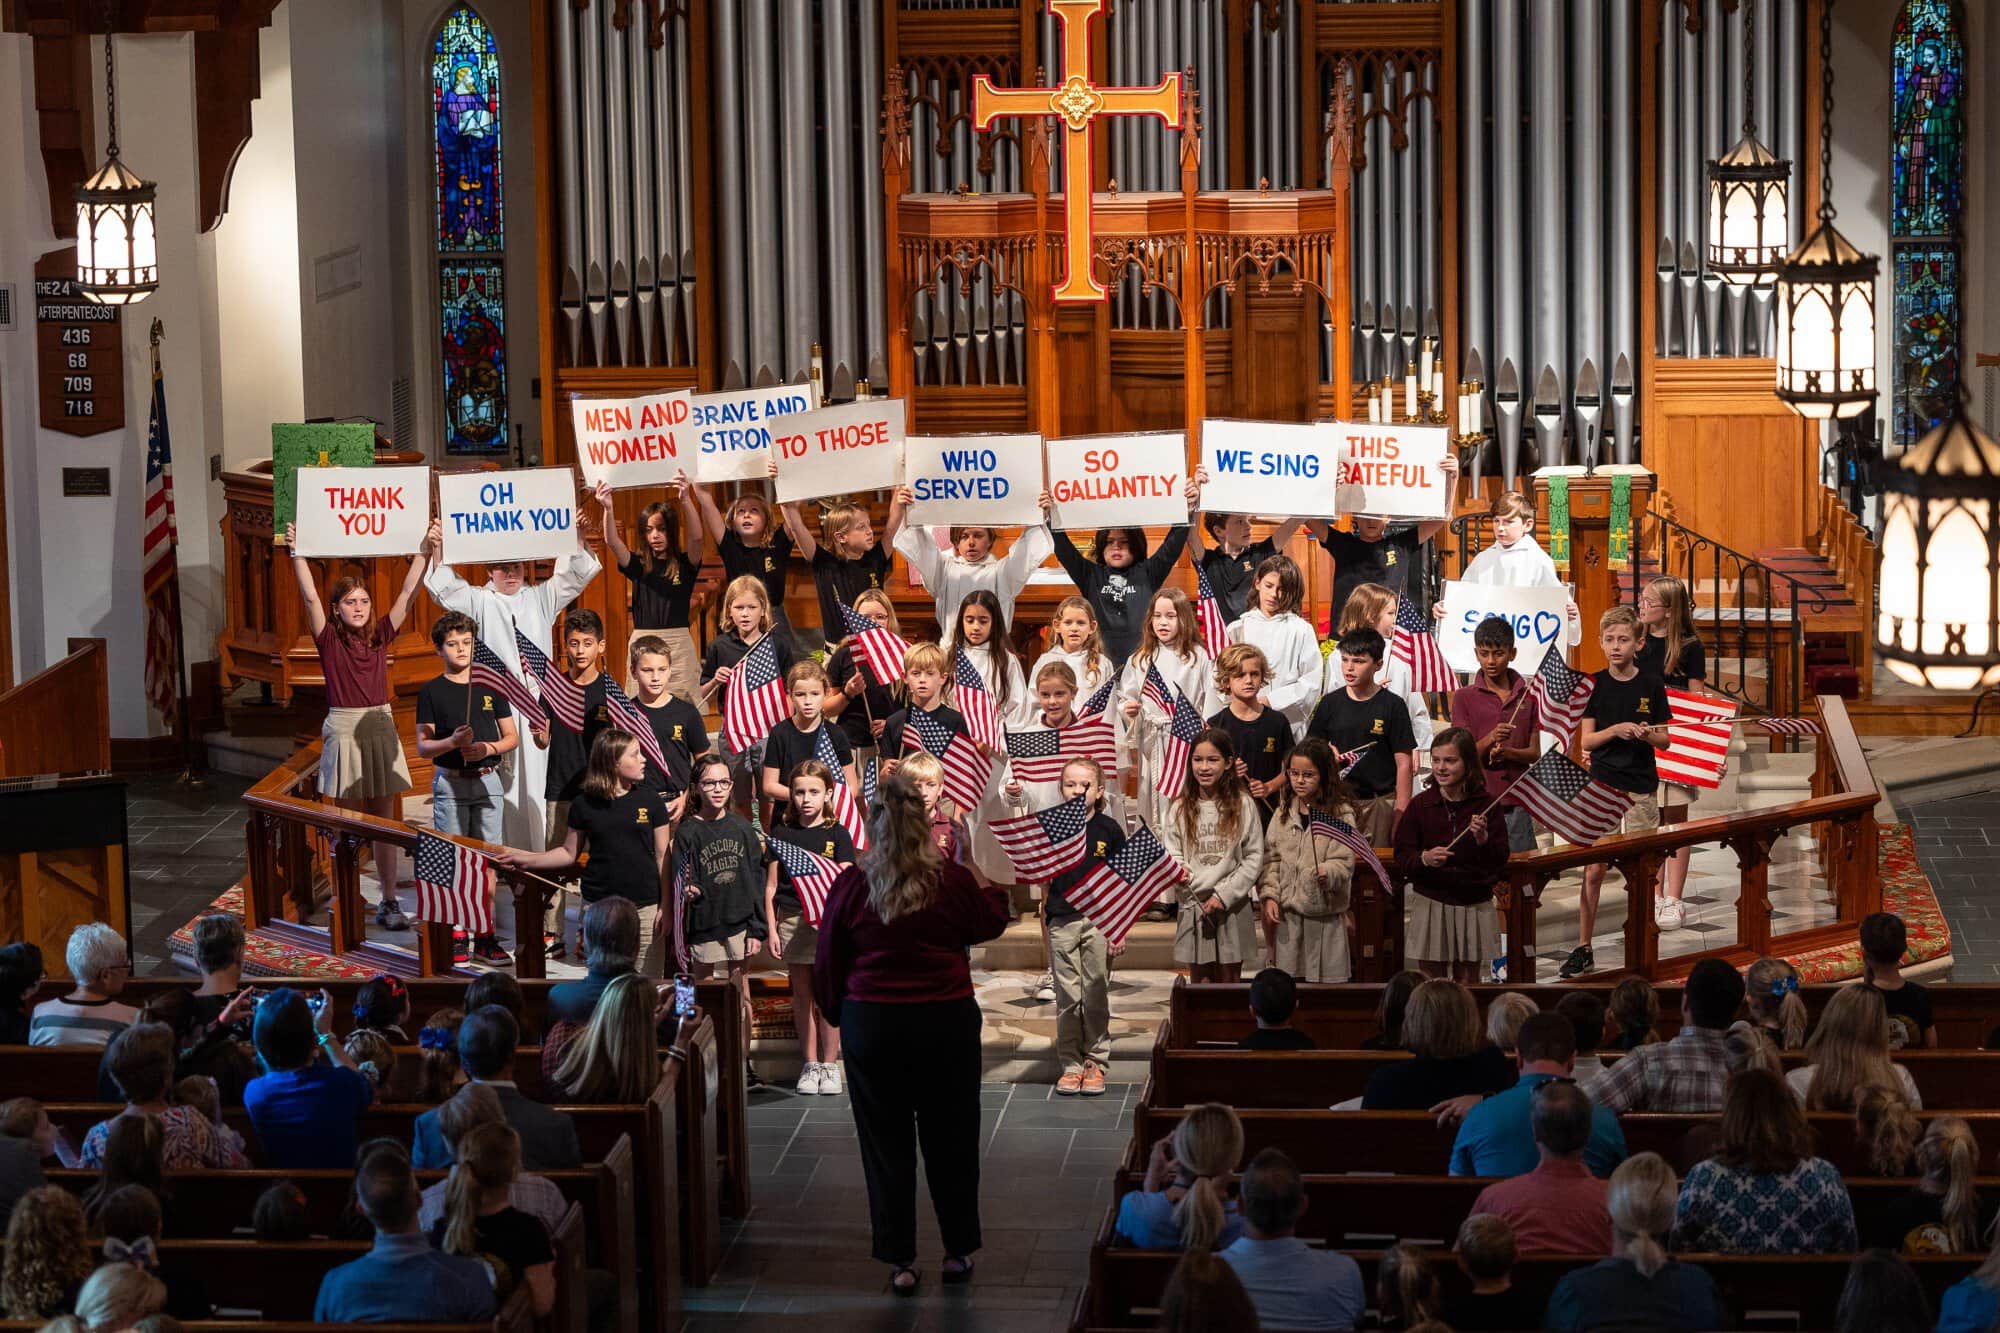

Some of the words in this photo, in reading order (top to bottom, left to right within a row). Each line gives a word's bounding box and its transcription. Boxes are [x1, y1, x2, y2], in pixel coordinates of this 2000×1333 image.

[36, 282, 52, 296] THE
[52, 281, 70, 297] 24
[38, 305, 61, 320] AFTER
[62, 305, 115, 320] PENTECOST
[63, 329, 90, 344] 436
[68, 353, 87, 368] 68
[64, 377, 92, 392] 709
[66, 401, 93, 415] 718
[585, 405, 632, 433] MEN
[640, 399, 689, 430] AND
[692, 400, 759, 426] BRAVE
[765, 396, 807, 416] AND
[587, 432, 677, 465] WOMEN
[701, 427, 771, 453] STRON
[776, 433, 808, 459] TO
[815, 421, 889, 455] THOSE
[1346, 436, 1400, 460] THIS
[942, 449, 997, 473] WHO
[1084, 449, 1119, 473] SO
[1216, 449, 1253, 474] WE
[1259, 452, 1319, 479] SING
[1342, 462, 1432, 488] RATEFUL
[324, 486, 405, 509] THANK
[479, 481, 514, 507] OH
[914, 477, 1010, 501] SERVED
[1053, 474, 1178, 503] GALLANTLY
[338, 513, 386, 536] YOU
[450, 509, 525, 534] THANK
[528, 507, 570, 531] YOU
[1462, 609, 1530, 639] SNG
[484, 695, 493, 708] E
[674, 726, 683, 738] E
[1374, 720, 1384, 731] E
[638, 808, 648, 819] E
[700, 838, 744, 865] EPISCOPAL
[707, 855, 739, 875] EAGLES
